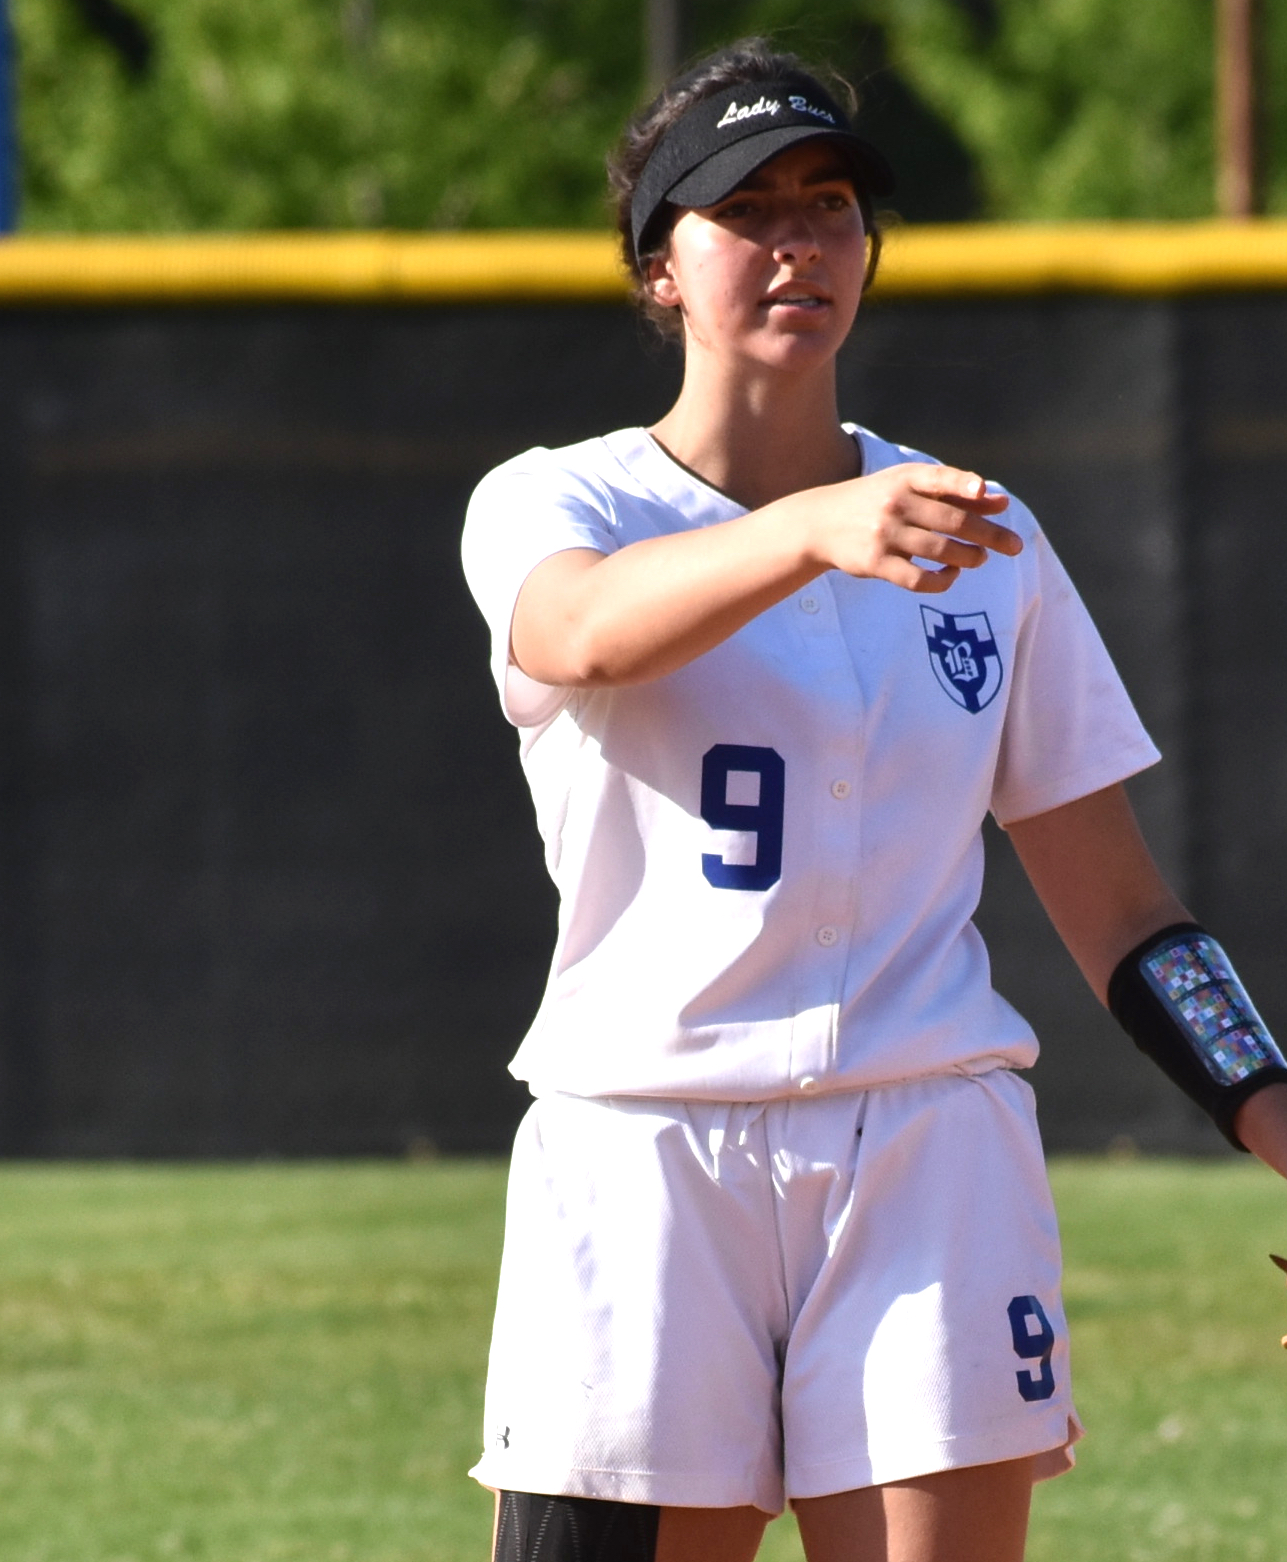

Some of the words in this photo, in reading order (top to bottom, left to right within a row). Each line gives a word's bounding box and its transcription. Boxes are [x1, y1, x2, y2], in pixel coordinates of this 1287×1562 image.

[717, 96, 781, 129] Lady
[701, 743, 786, 892] 9
[1006, 1295, 1055, 1402] 9
